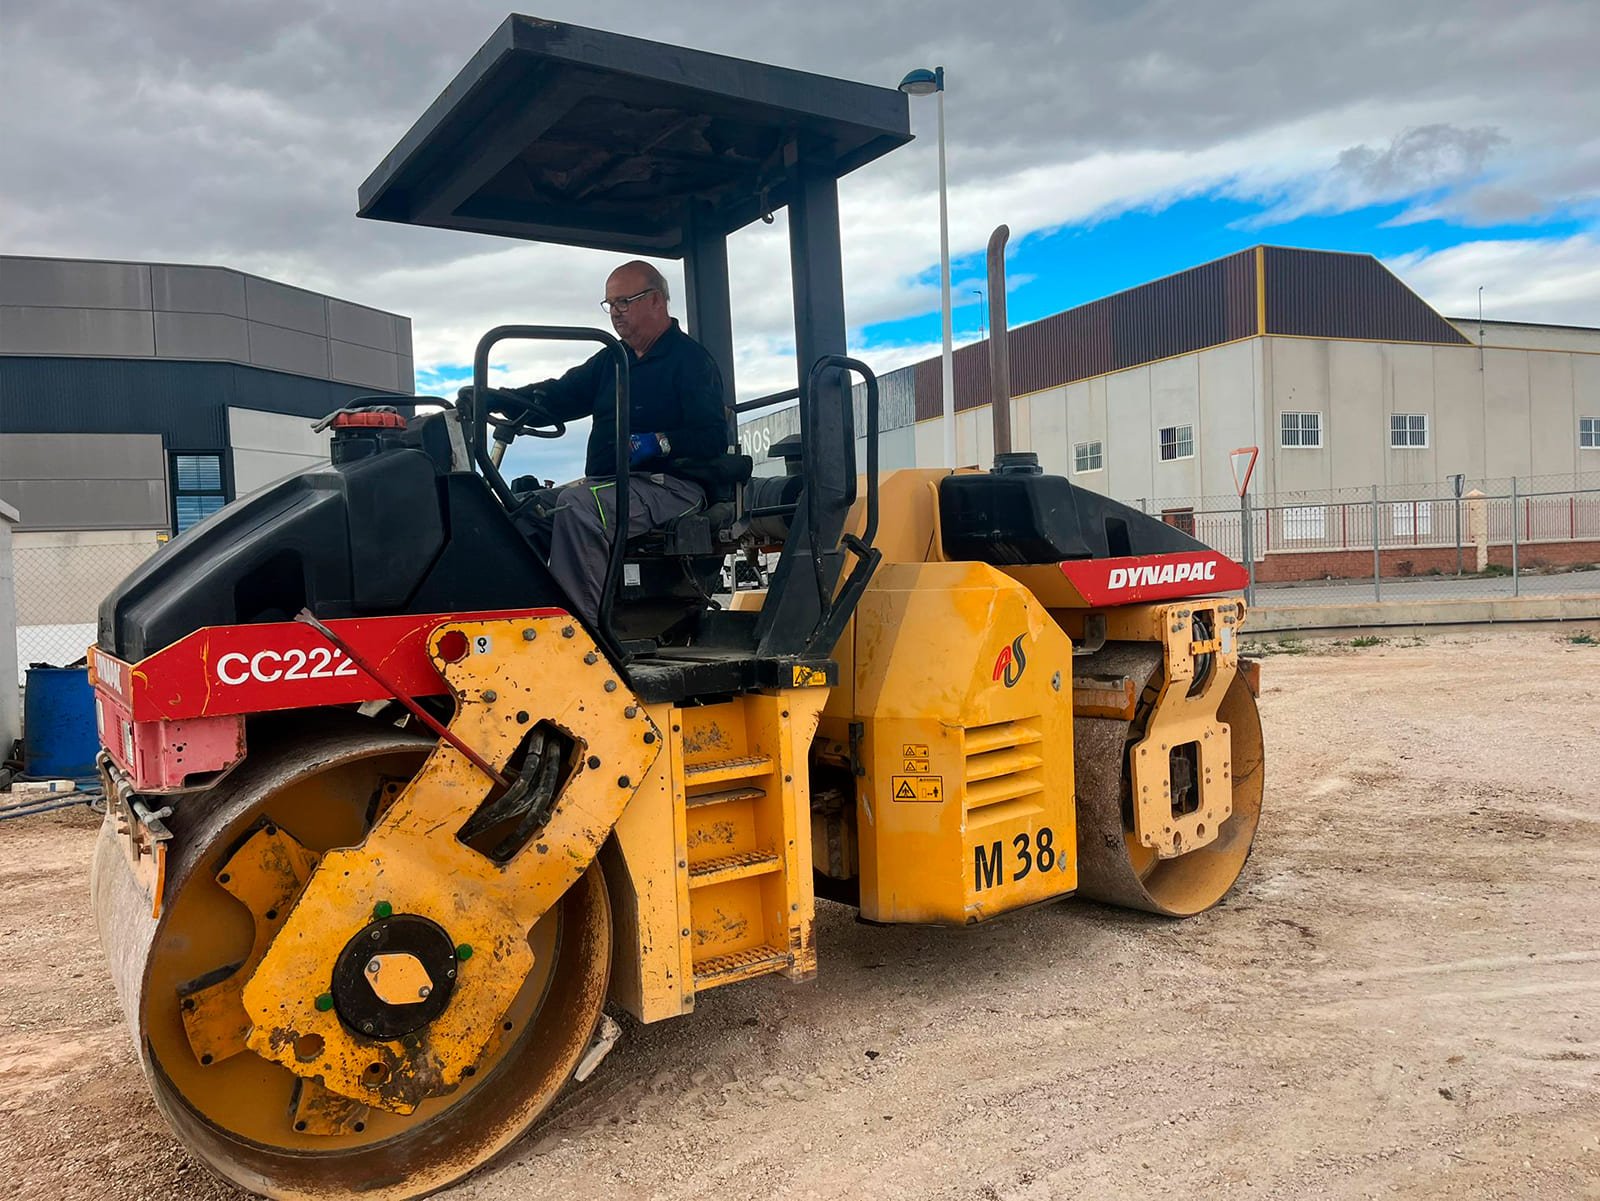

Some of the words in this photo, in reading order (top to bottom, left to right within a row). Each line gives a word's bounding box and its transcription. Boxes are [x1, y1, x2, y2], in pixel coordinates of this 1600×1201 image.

[1107, 561, 1217, 589] DYNAPAC
[217, 647, 357, 685] CC222
[974, 840, 1003, 892] M
[1013, 827, 1055, 882] 38
